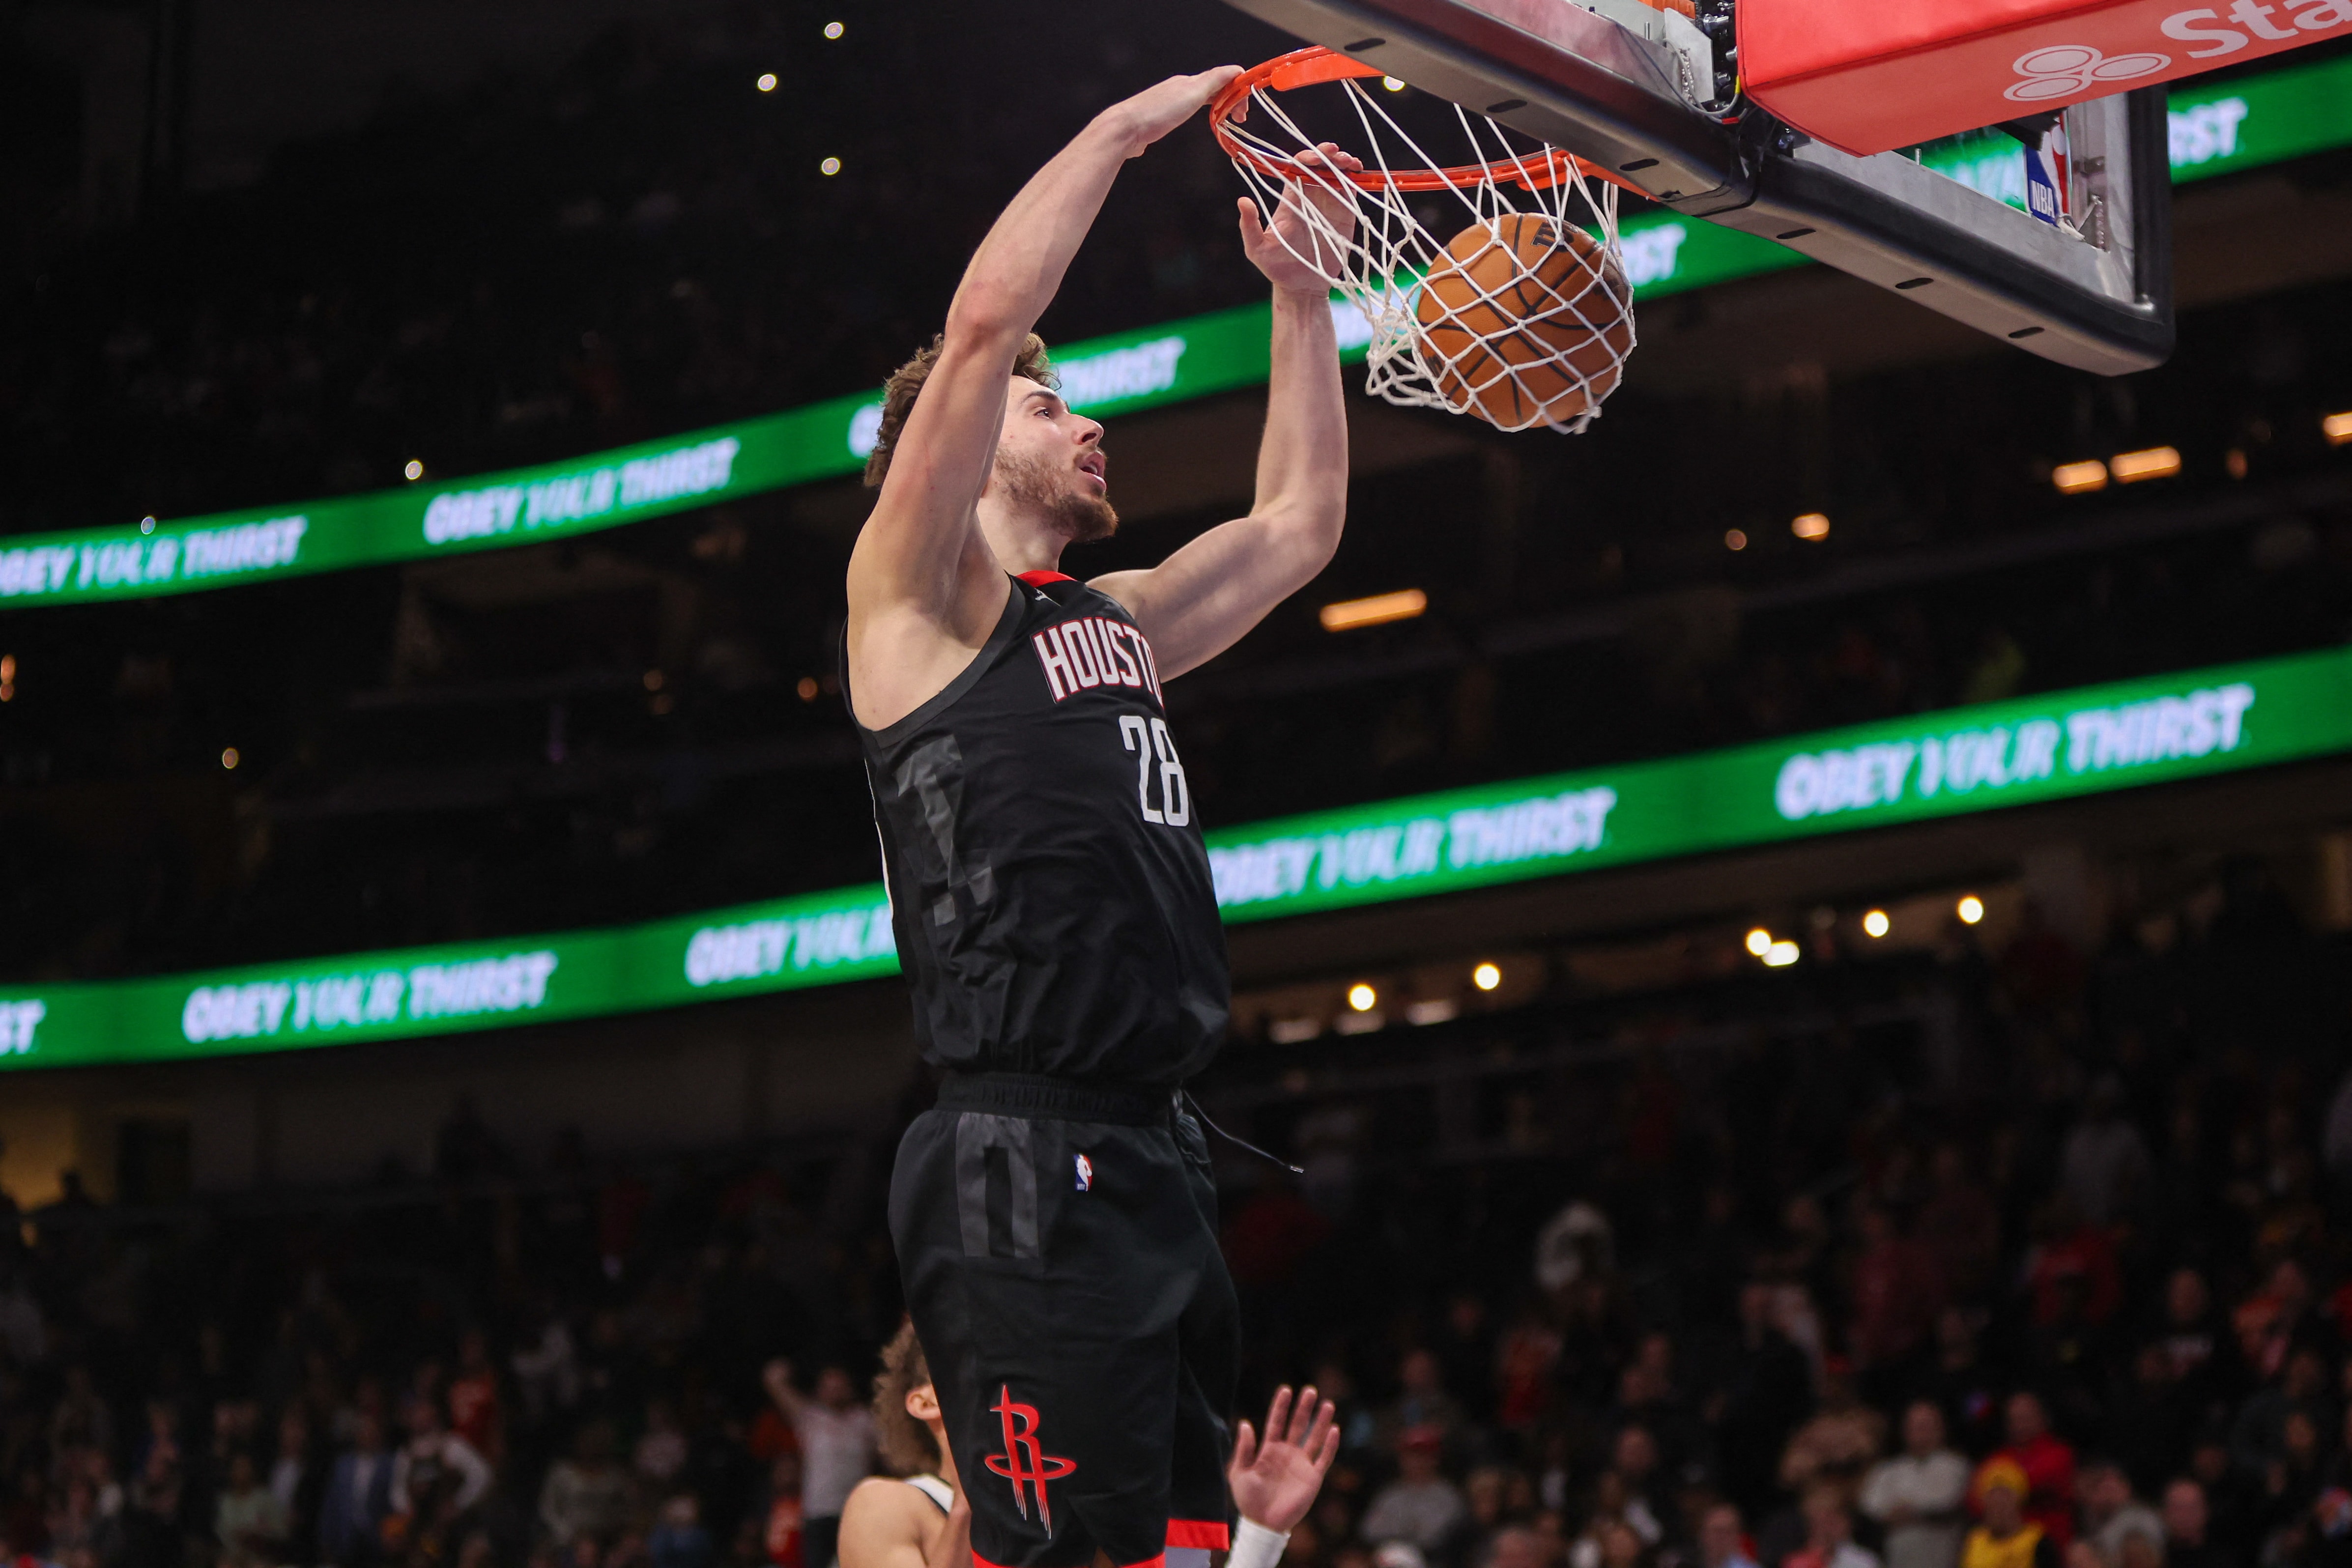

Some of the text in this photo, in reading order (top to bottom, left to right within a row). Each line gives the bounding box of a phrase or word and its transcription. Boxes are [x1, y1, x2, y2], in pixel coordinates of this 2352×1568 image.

[2031, 179, 2056, 220] NBA
[183, 514, 308, 577] THIRST
[1119, 715, 1189, 827] 28
[1775, 742, 1915, 820] OBEY
[2066, 683, 2256, 774] THIRST
[1447, 786, 1617, 871] THIRST
[408, 950, 558, 1021] THIRST
